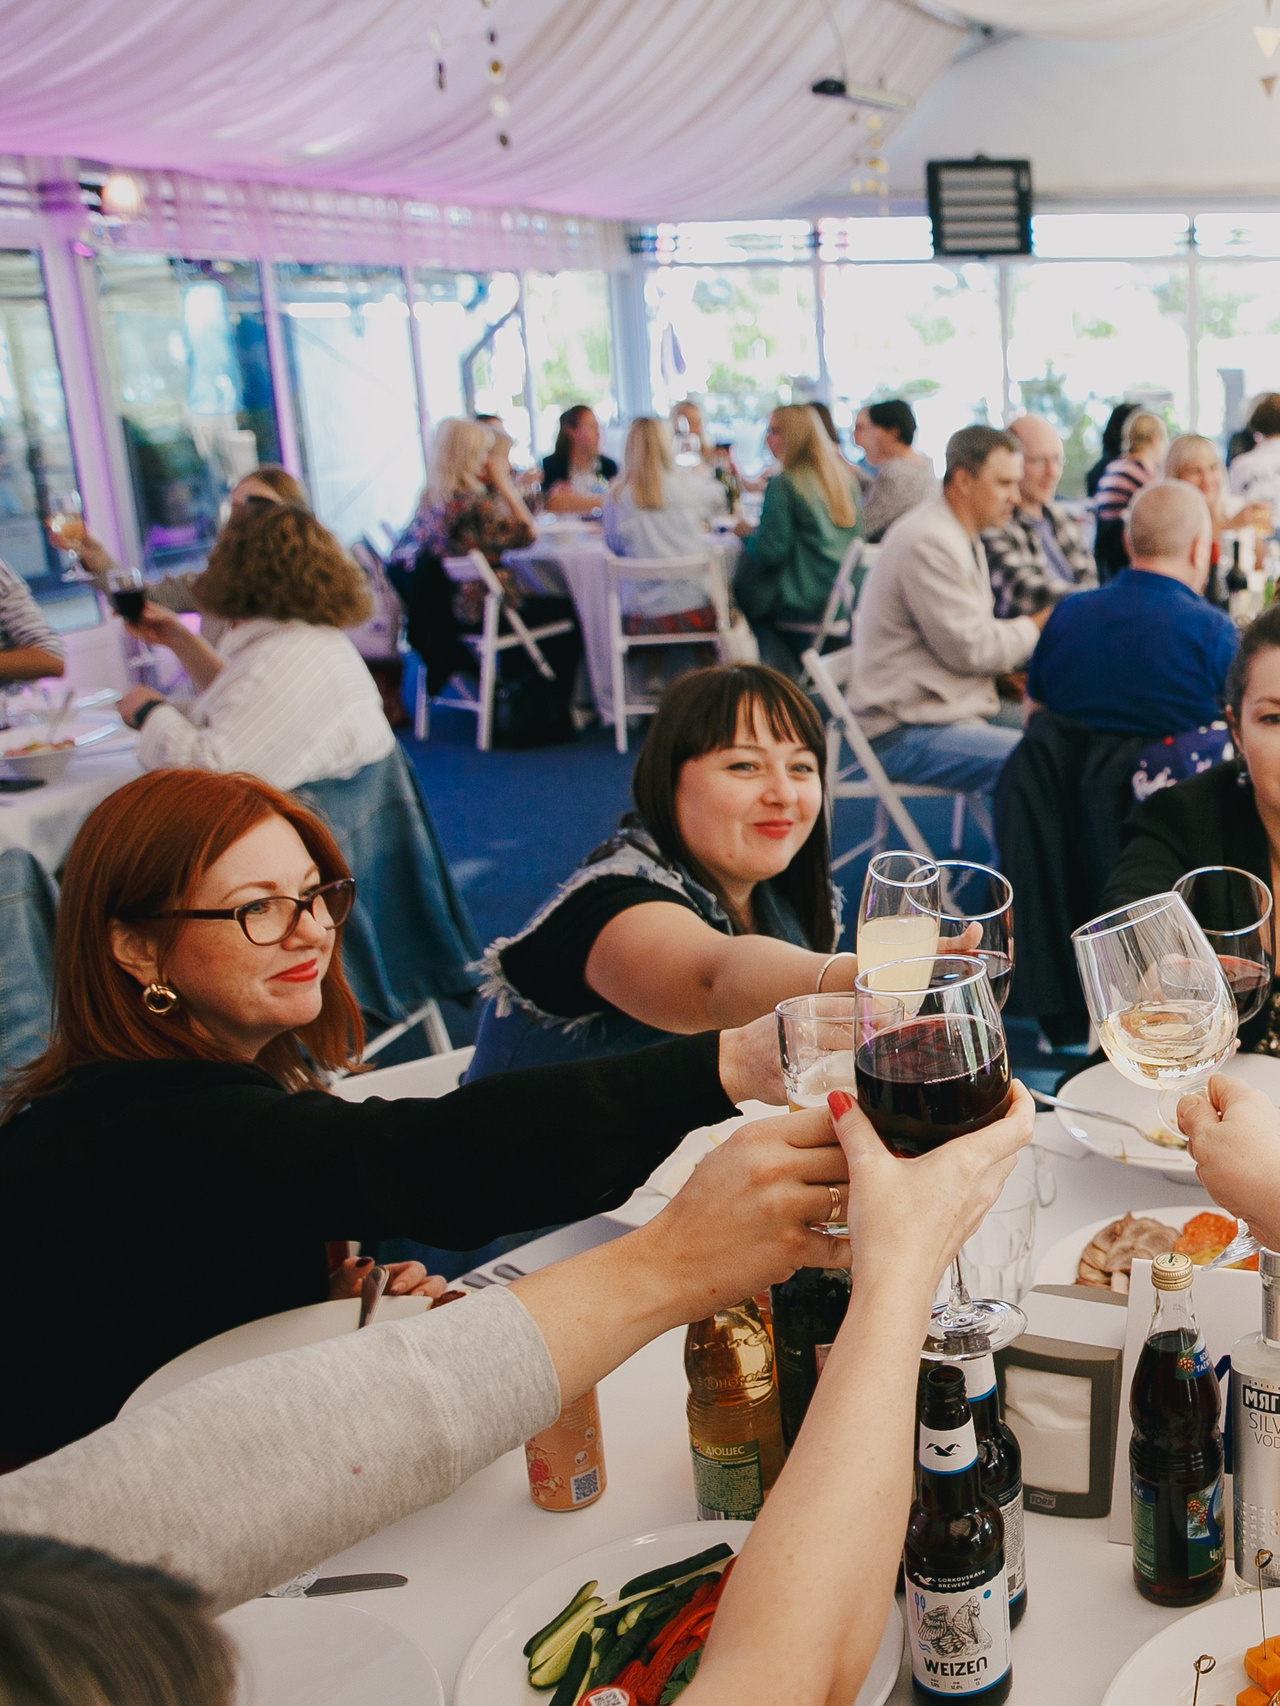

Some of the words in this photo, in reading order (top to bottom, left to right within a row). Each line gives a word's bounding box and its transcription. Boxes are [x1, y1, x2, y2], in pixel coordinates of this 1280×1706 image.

[706, 1446, 745, 1456] ДЮШЕС
[1031, 1495, 1054, 1507] TORK
[937, 1569, 986, 1583] GORKOVSKAYA
[923, 1656, 988, 1676] WEIZEN
